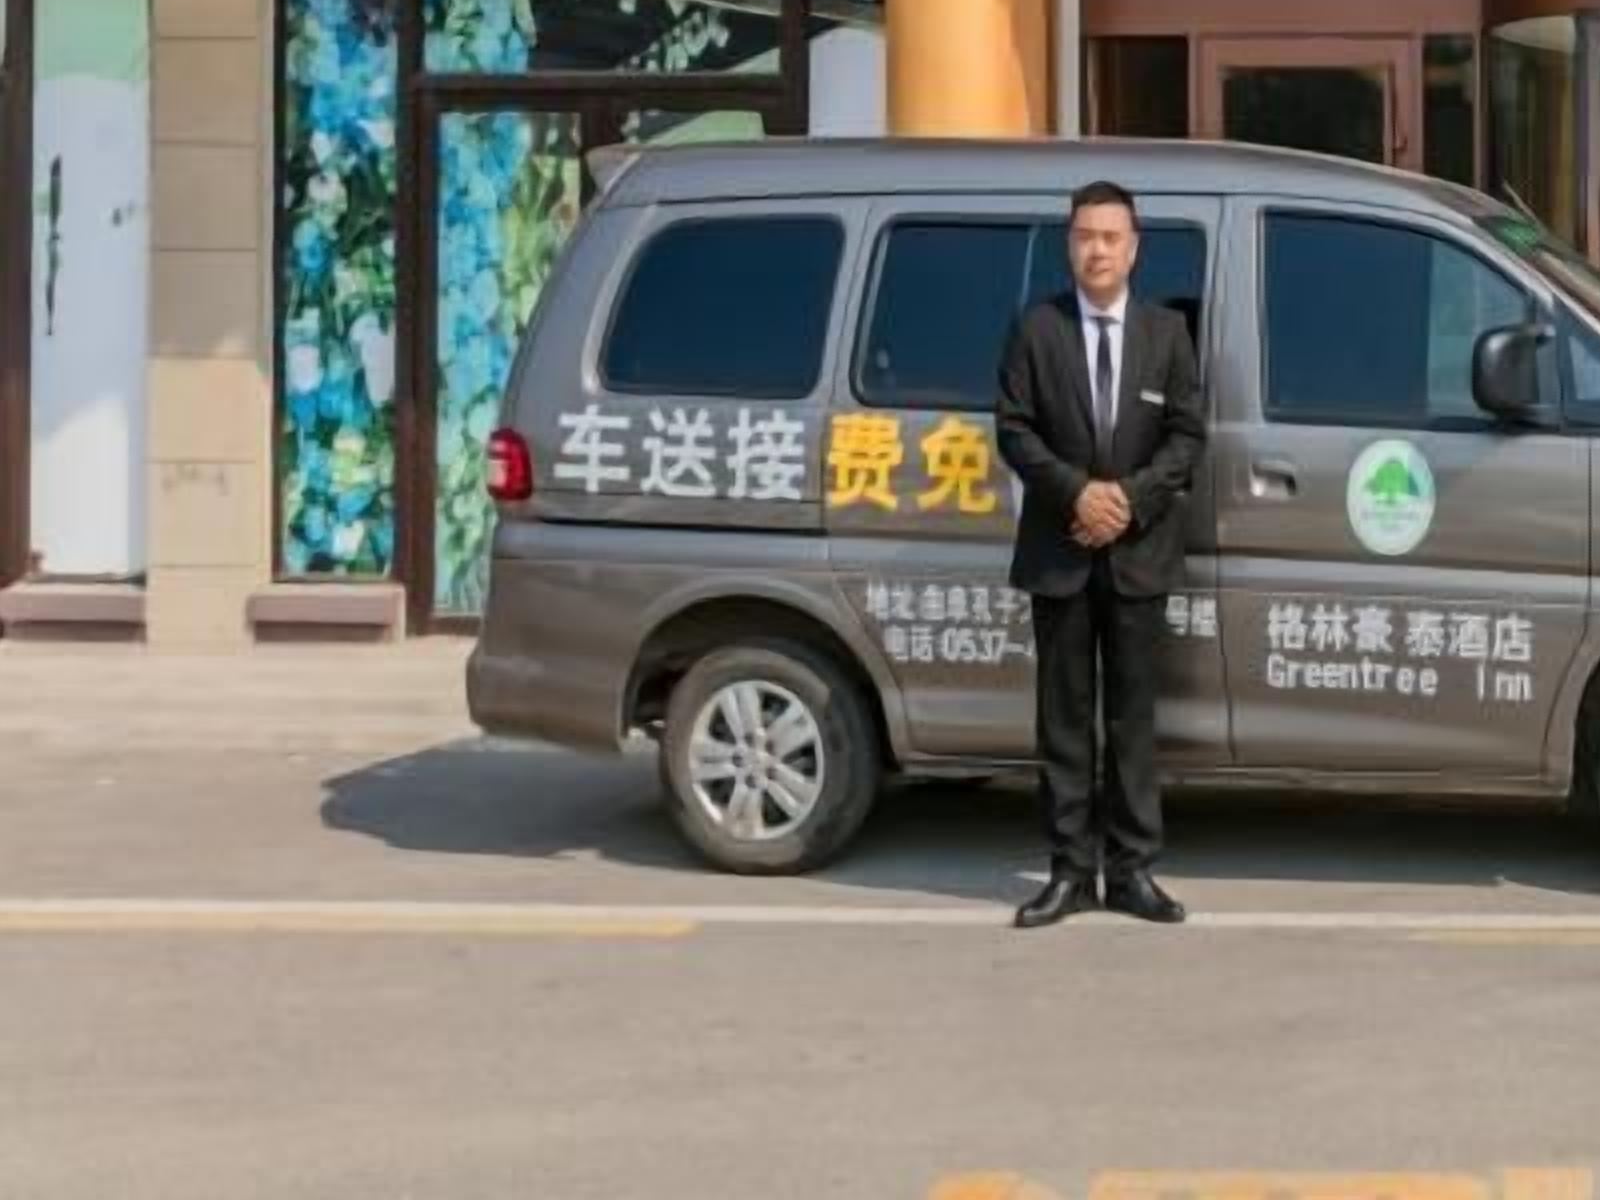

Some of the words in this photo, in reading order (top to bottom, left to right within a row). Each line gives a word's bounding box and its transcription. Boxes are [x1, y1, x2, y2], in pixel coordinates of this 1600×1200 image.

[1267, 603, 1534, 662] 格林豪泰酒店
[1267, 652, 1439, 696] Greentree
